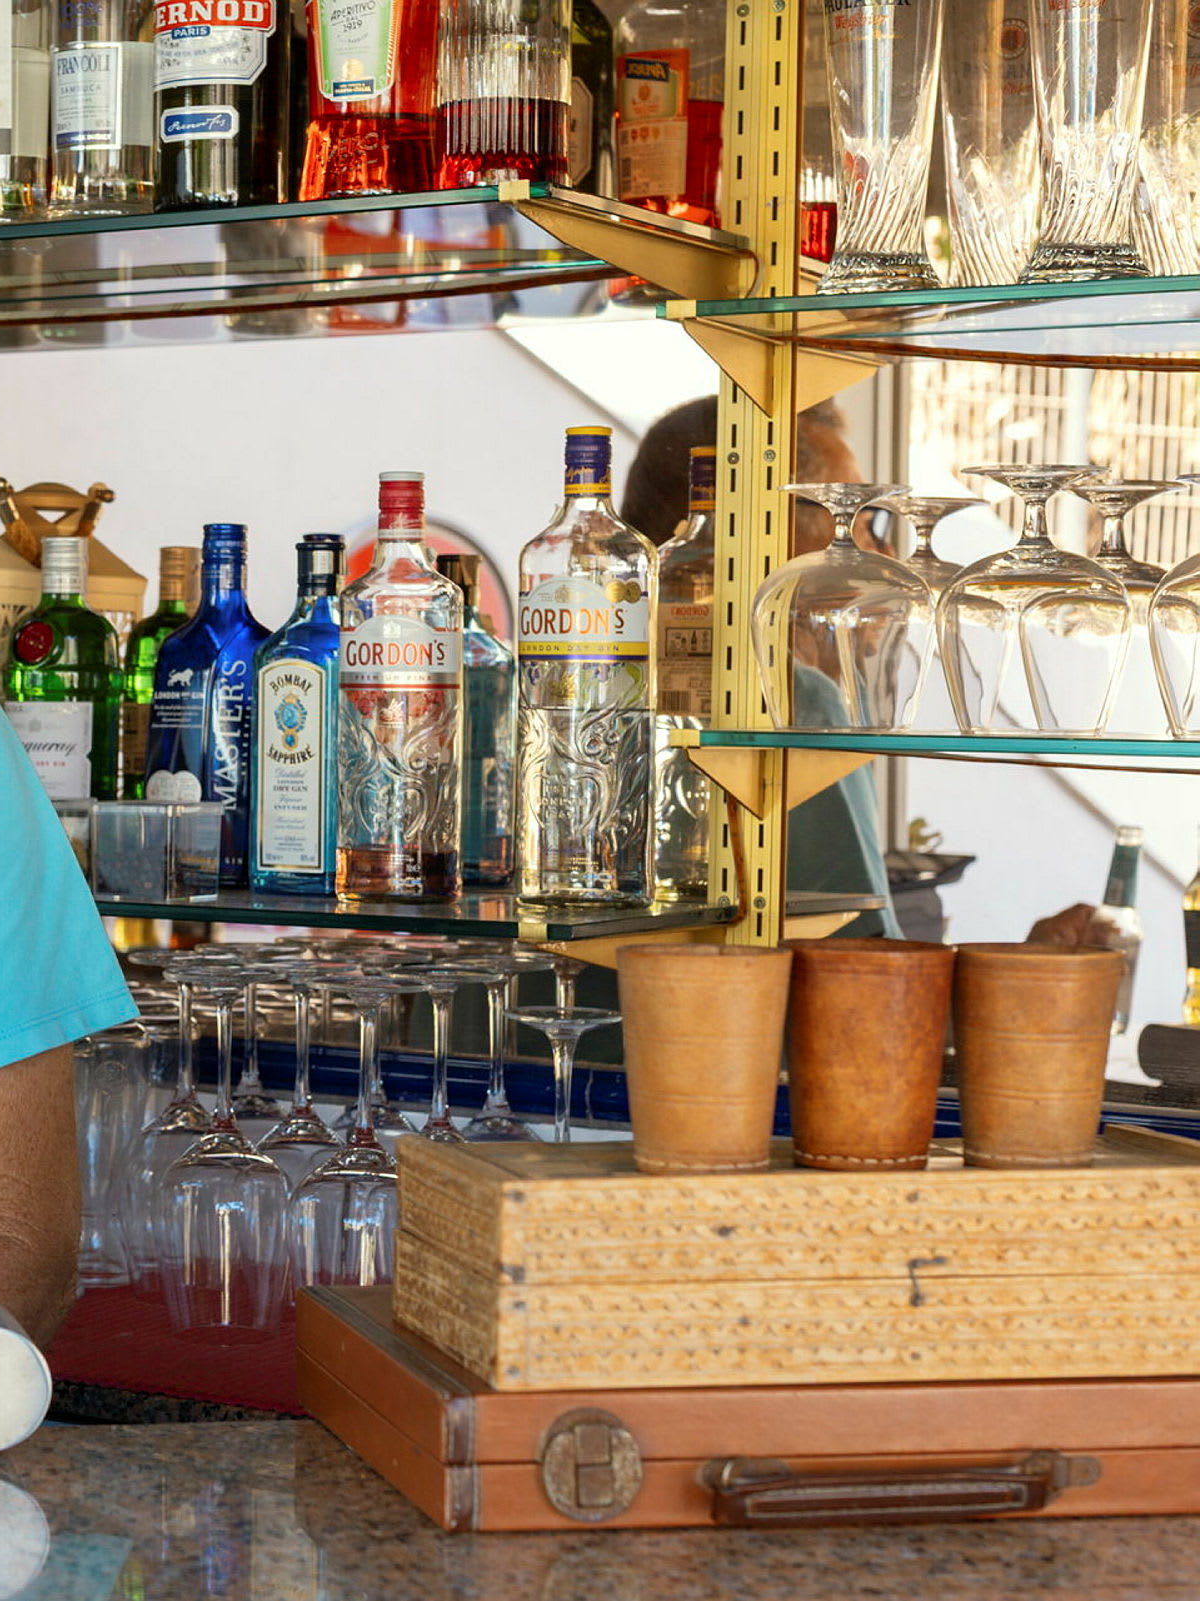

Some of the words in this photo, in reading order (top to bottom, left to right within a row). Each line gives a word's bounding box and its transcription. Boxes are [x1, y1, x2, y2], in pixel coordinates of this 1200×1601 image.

[174, 29, 208, 37] PARIS
[521, 606, 624, 635] GORDON'S
[347, 641, 445, 666] GORDON'S
[269, 674, 312, 696] BOMBAY
[213, 658, 248, 811] MASTER'S
[267, 743, 316, 764] SAPPHIRE
